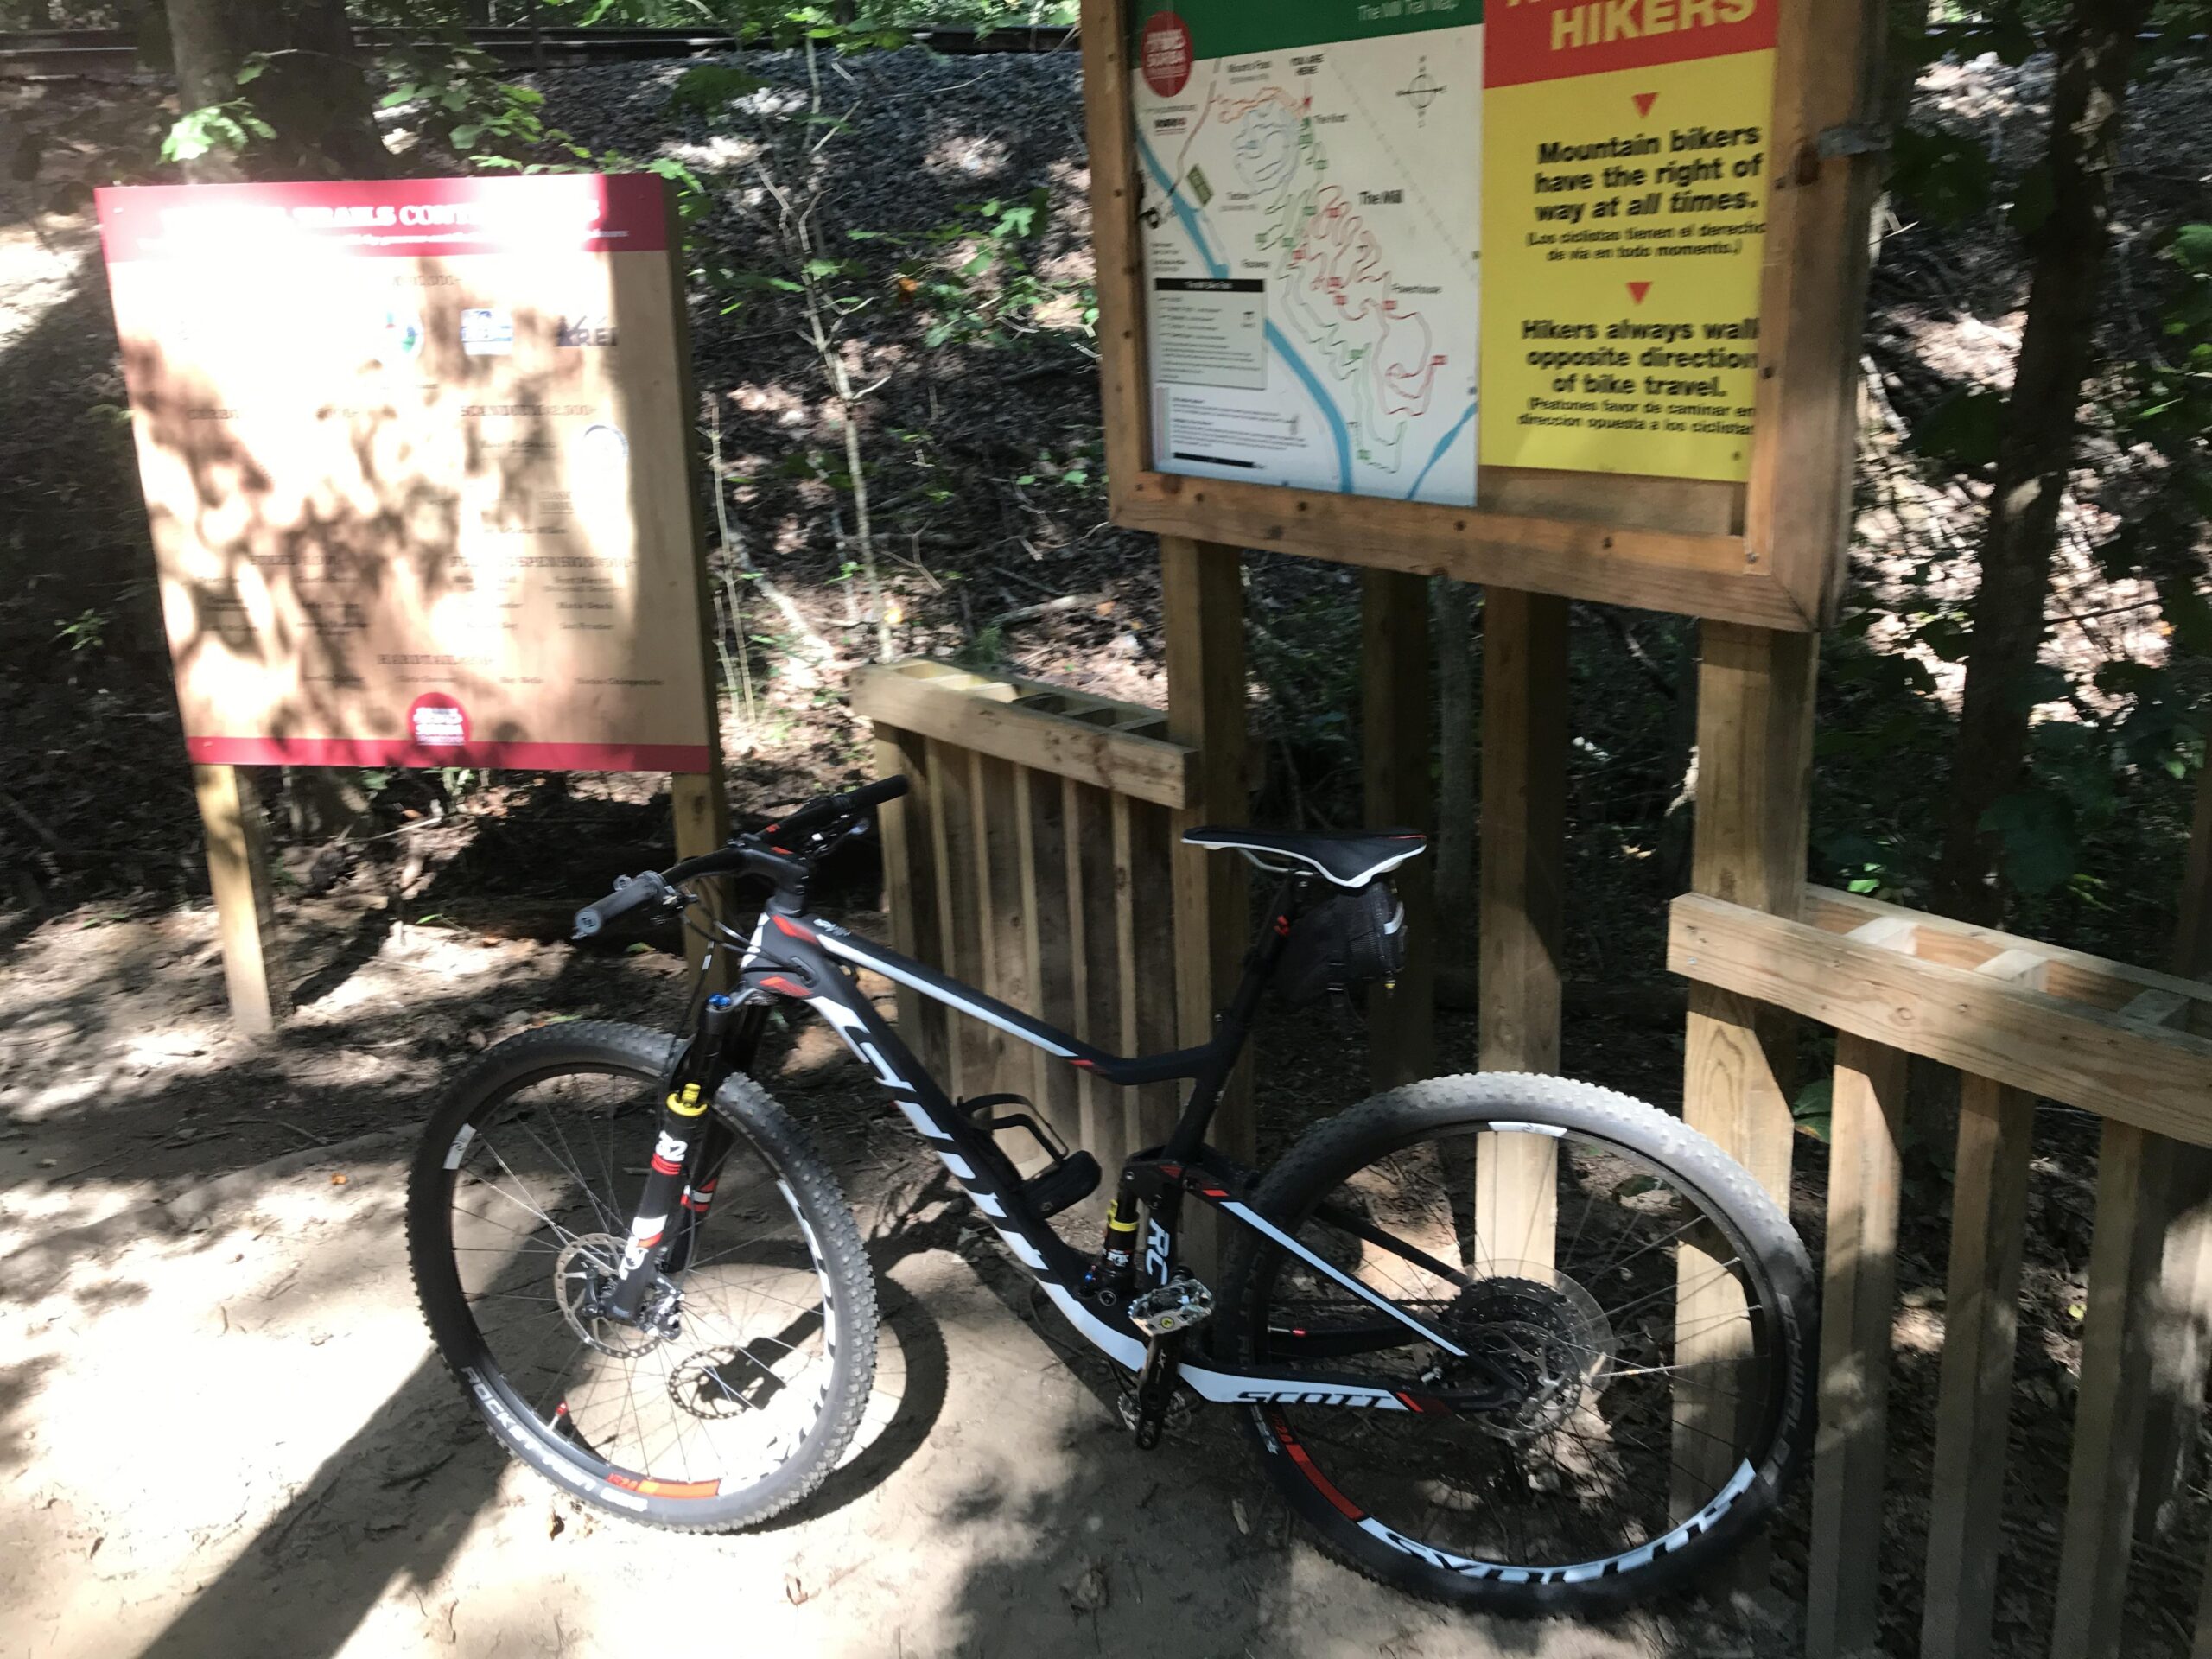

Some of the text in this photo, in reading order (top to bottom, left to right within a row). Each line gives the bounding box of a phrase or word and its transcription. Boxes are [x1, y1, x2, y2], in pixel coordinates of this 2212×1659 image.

[1551, 0, 1758, 50] HIKERS
[1537, 126, 1762, 164] Mountain bikers
[1534, 152, 1765, 194] have the right of
[1535, 190, 1759, 223] way at all times.
[1522, 320, 1599, 340] Hikers
[1605, 319, 1694, 343] always
[1526, 346, 1758, 369] opposite direction
[1553, 373, 1727, 397] of bike travel.
[460, 1366, 548, 1455] ROCKET
[1234, 1390, 1393, 1408] SCOTT
